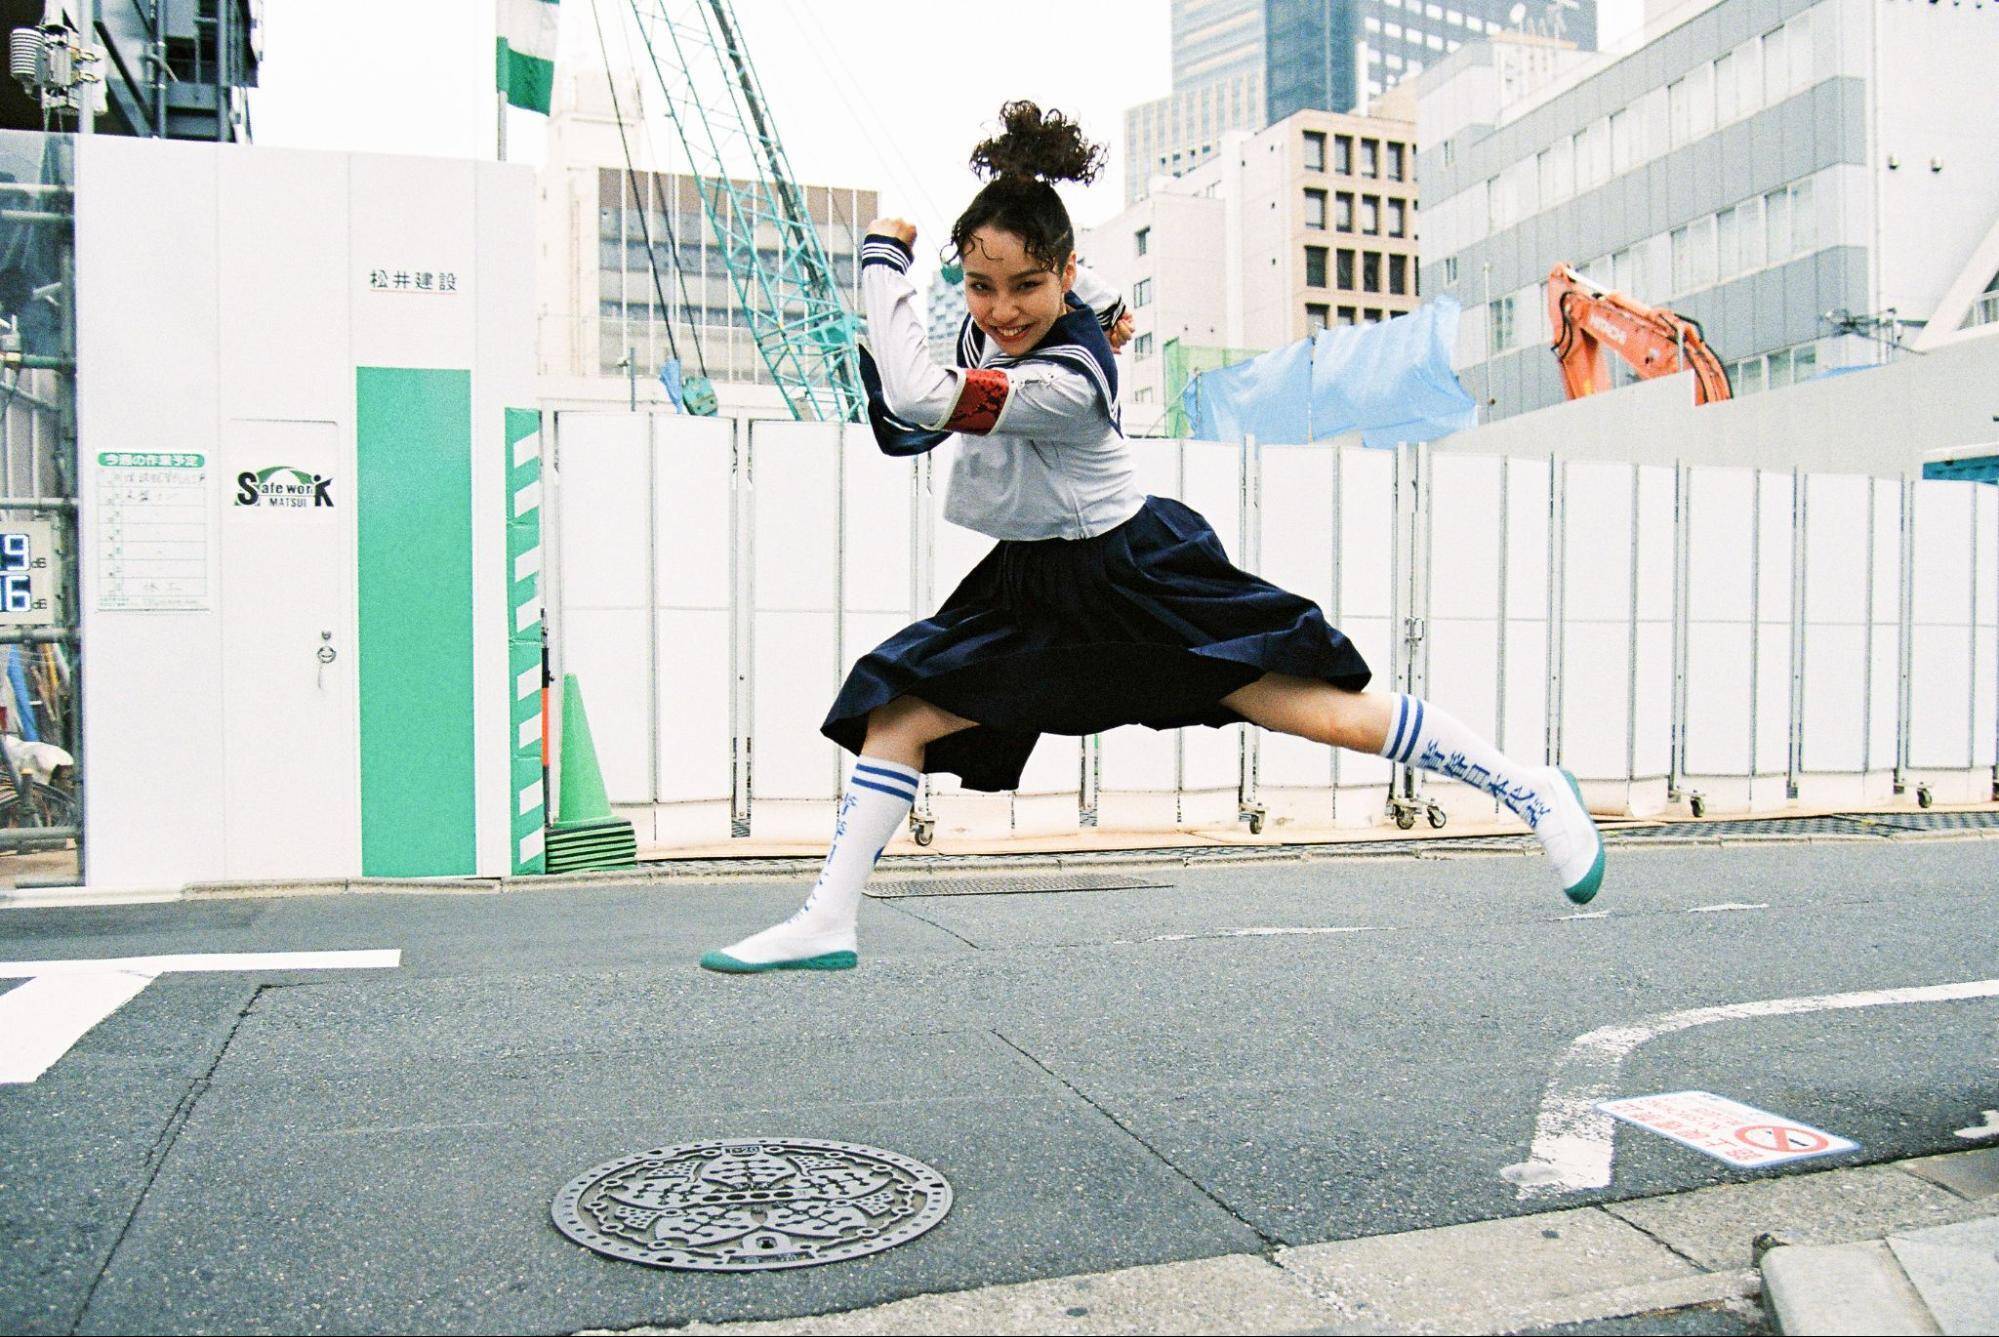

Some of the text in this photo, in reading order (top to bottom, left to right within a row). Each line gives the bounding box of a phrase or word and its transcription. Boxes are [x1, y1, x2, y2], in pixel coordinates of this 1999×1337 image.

[369, 270, 457, 291] 松井建設
[237, 472, 283, 505] Safe
[269, 498, 307, 507] MATSUI
[0, 575, 31, 612] 6
